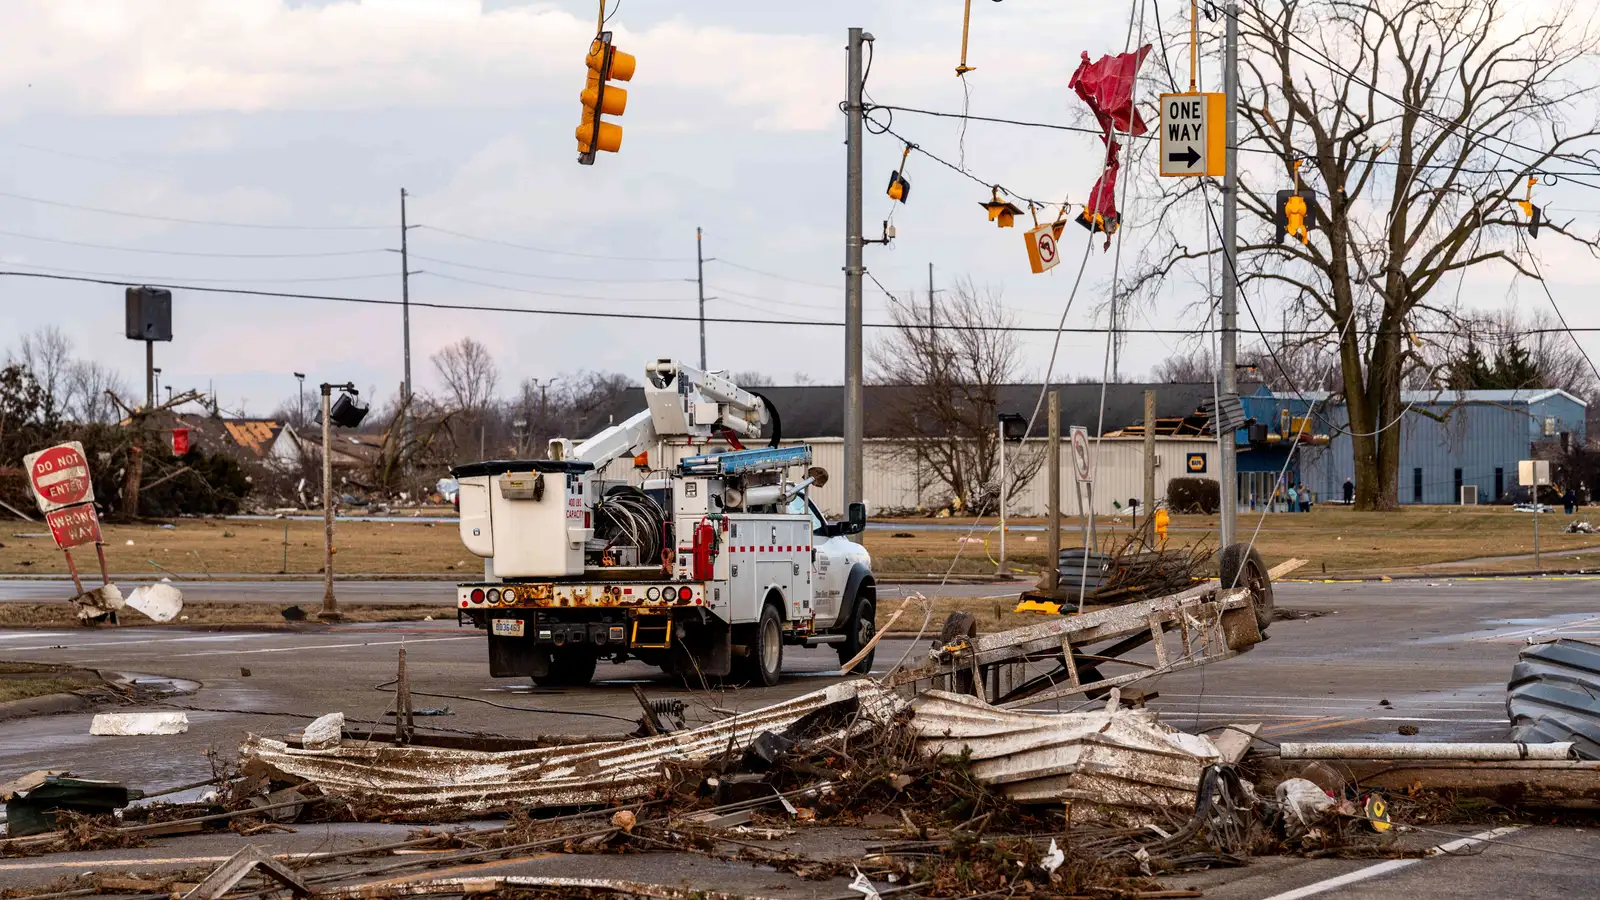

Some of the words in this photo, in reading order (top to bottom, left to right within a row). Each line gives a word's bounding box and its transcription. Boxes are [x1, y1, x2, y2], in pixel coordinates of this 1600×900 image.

[1169, 101, 1201, 120] ONE
[1168, 123, 1202, 142] WAY
[36, 460, 53, 474] DO
[57, 453, 79, 467] NOT
[49, 478, 84, 498] ENTER
[53, 509, 97, 529] WRONG
[566, 509, 584, 519] CAPACITY
[68, 525, 93, 540] WAY
